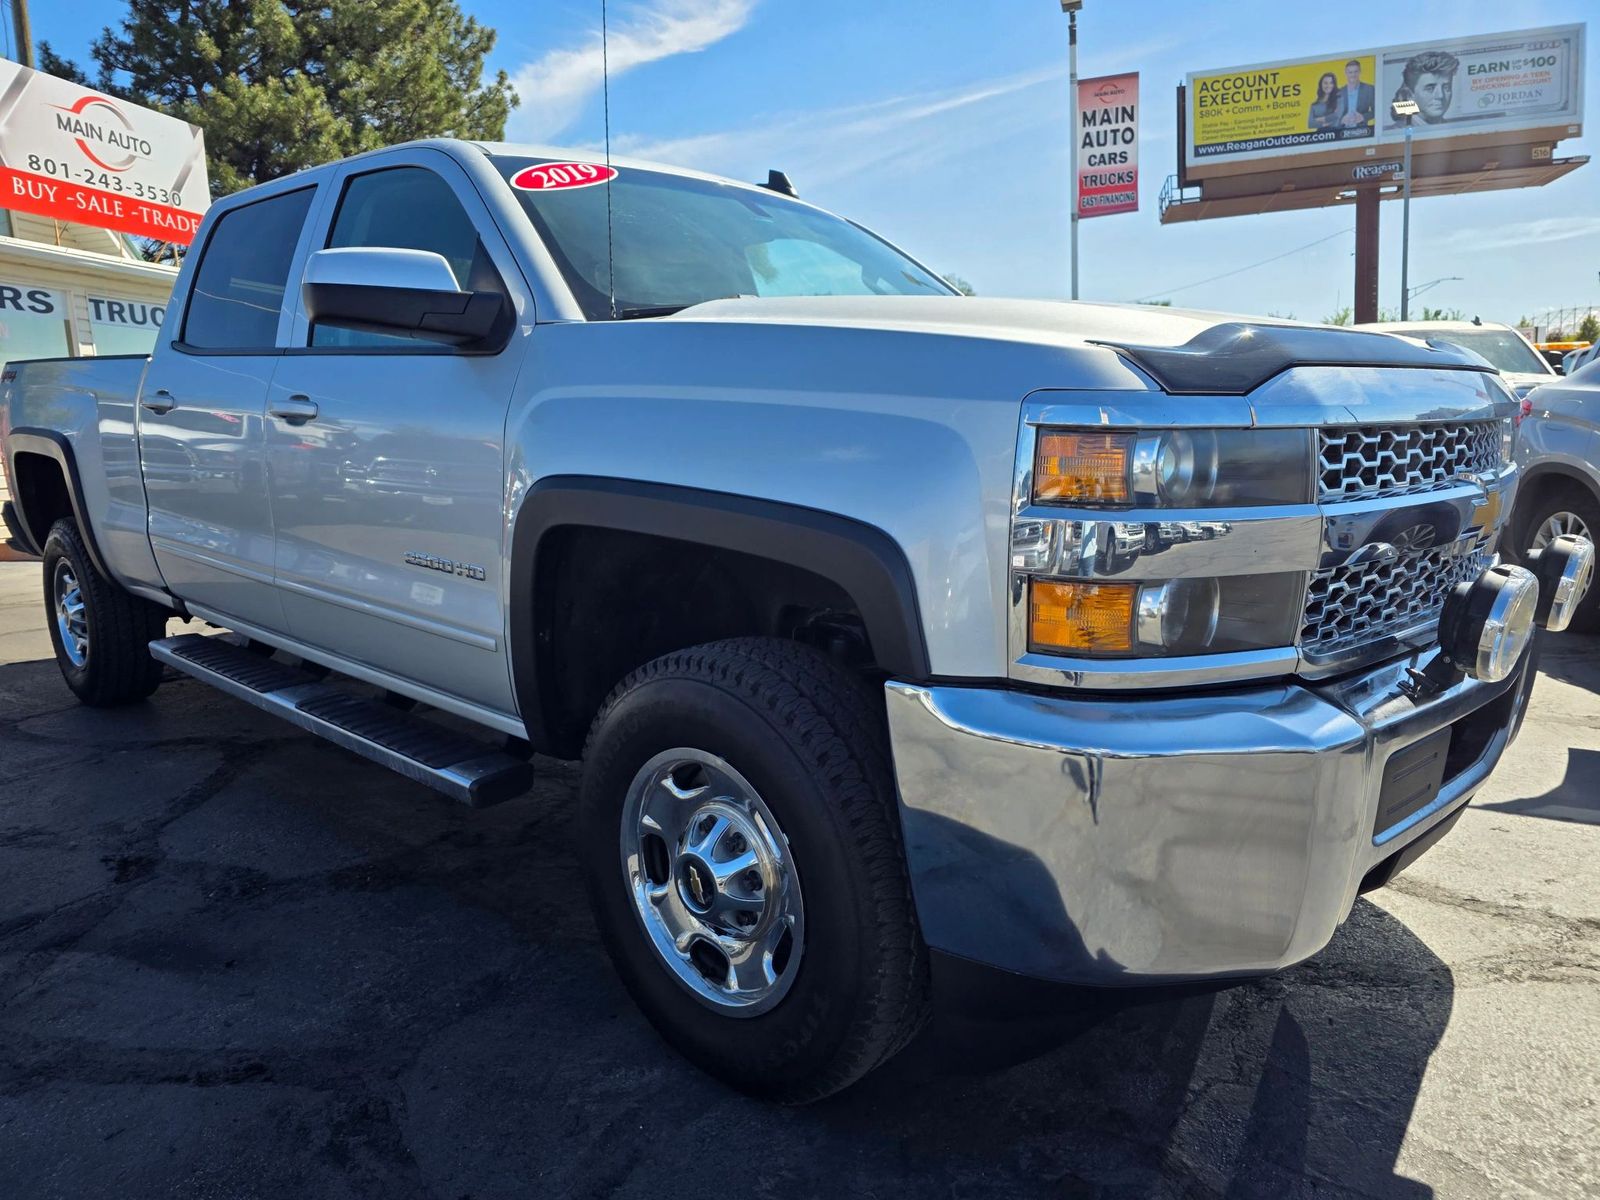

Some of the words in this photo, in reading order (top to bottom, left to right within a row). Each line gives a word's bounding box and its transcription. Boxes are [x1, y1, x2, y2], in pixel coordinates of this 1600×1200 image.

[1467, 61, 1510, 75] EARN
[1523, 55, 1557, 68] $100
[1199, 72, 1280, 94] ACCOUNT
[1199, 84, 1301, 108] EXECUTIVES
[1498, 89, 1543, 104] JORDAN
[1082, 105, 1135, 128] MAIN
[1199, 108, 1223, 119] $80K
[1232, 104, 1264, 115] Comm.
[1272, 100, 1301, 110] Bonus
[56, 113, 103, 142] MAIN
[108, 130, 152, 156] AUTO
[1081, 127, 1135, 149] AUTO
[1198, 131, 1336, 155] www.ReaganOutdoor.com
[1088, 151, 1128, 167] CARS
[1533, 148, 1550, 158] 516
[27, 154, 182, 207] 801-243-3530
[531, 164, 598, 188] 2019
[1083, 171, 1134, 187] TRUCKS
[1355, 163, 1400, 180] Reagan
[12, 176, 58, 203] BUY
[1082, 196, 1098, 208] EASY
[1099, 192, 1135, 205] FINANCING
[0, 285, 54, 314] RS
